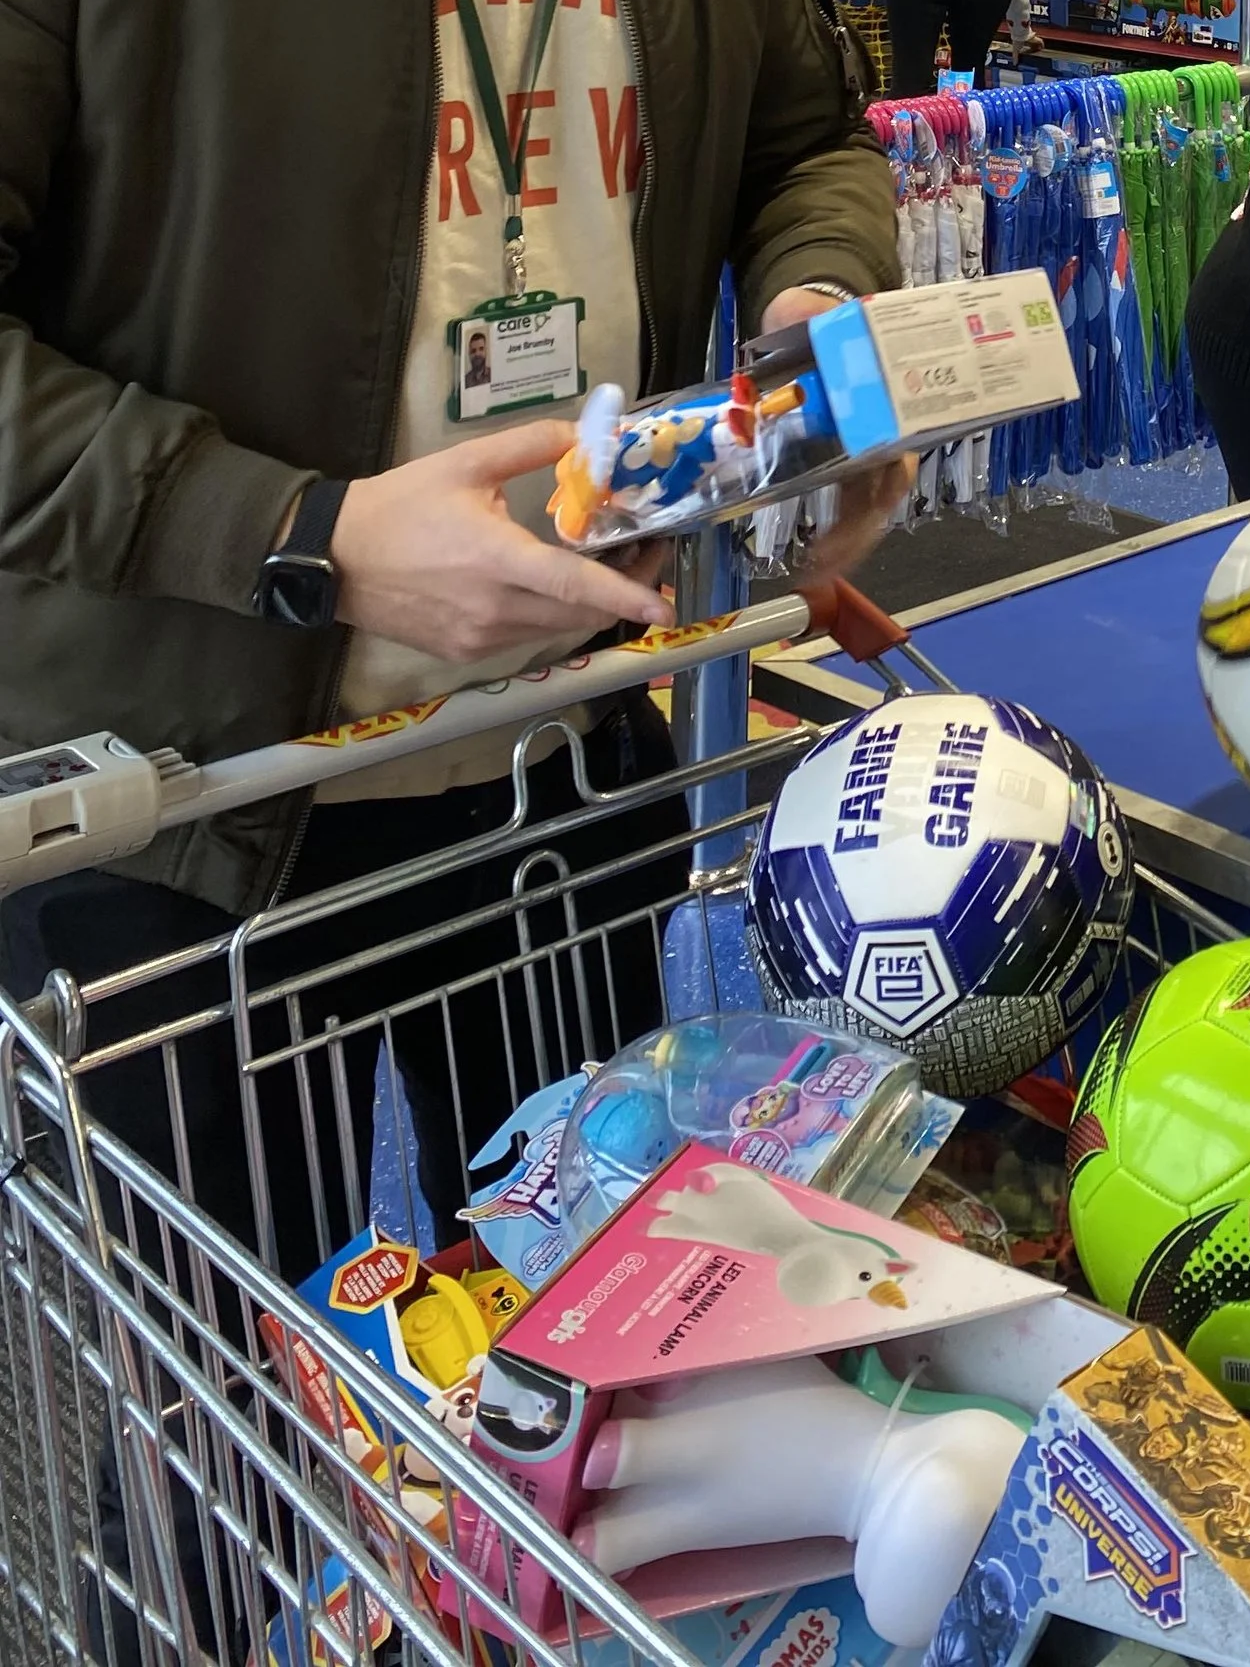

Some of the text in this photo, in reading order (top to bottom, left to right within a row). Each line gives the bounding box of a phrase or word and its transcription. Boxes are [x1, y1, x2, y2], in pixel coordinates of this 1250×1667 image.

[497, 316, 531, 332] care
[875, 956, 921, 973] FIFA
[678, 1255, 728, 1305] UNICORN
[658, 1260, 746, 1358] LED ANIMAL LAMP
[1055, 1481, 1156, 1604] UNIVERSE
